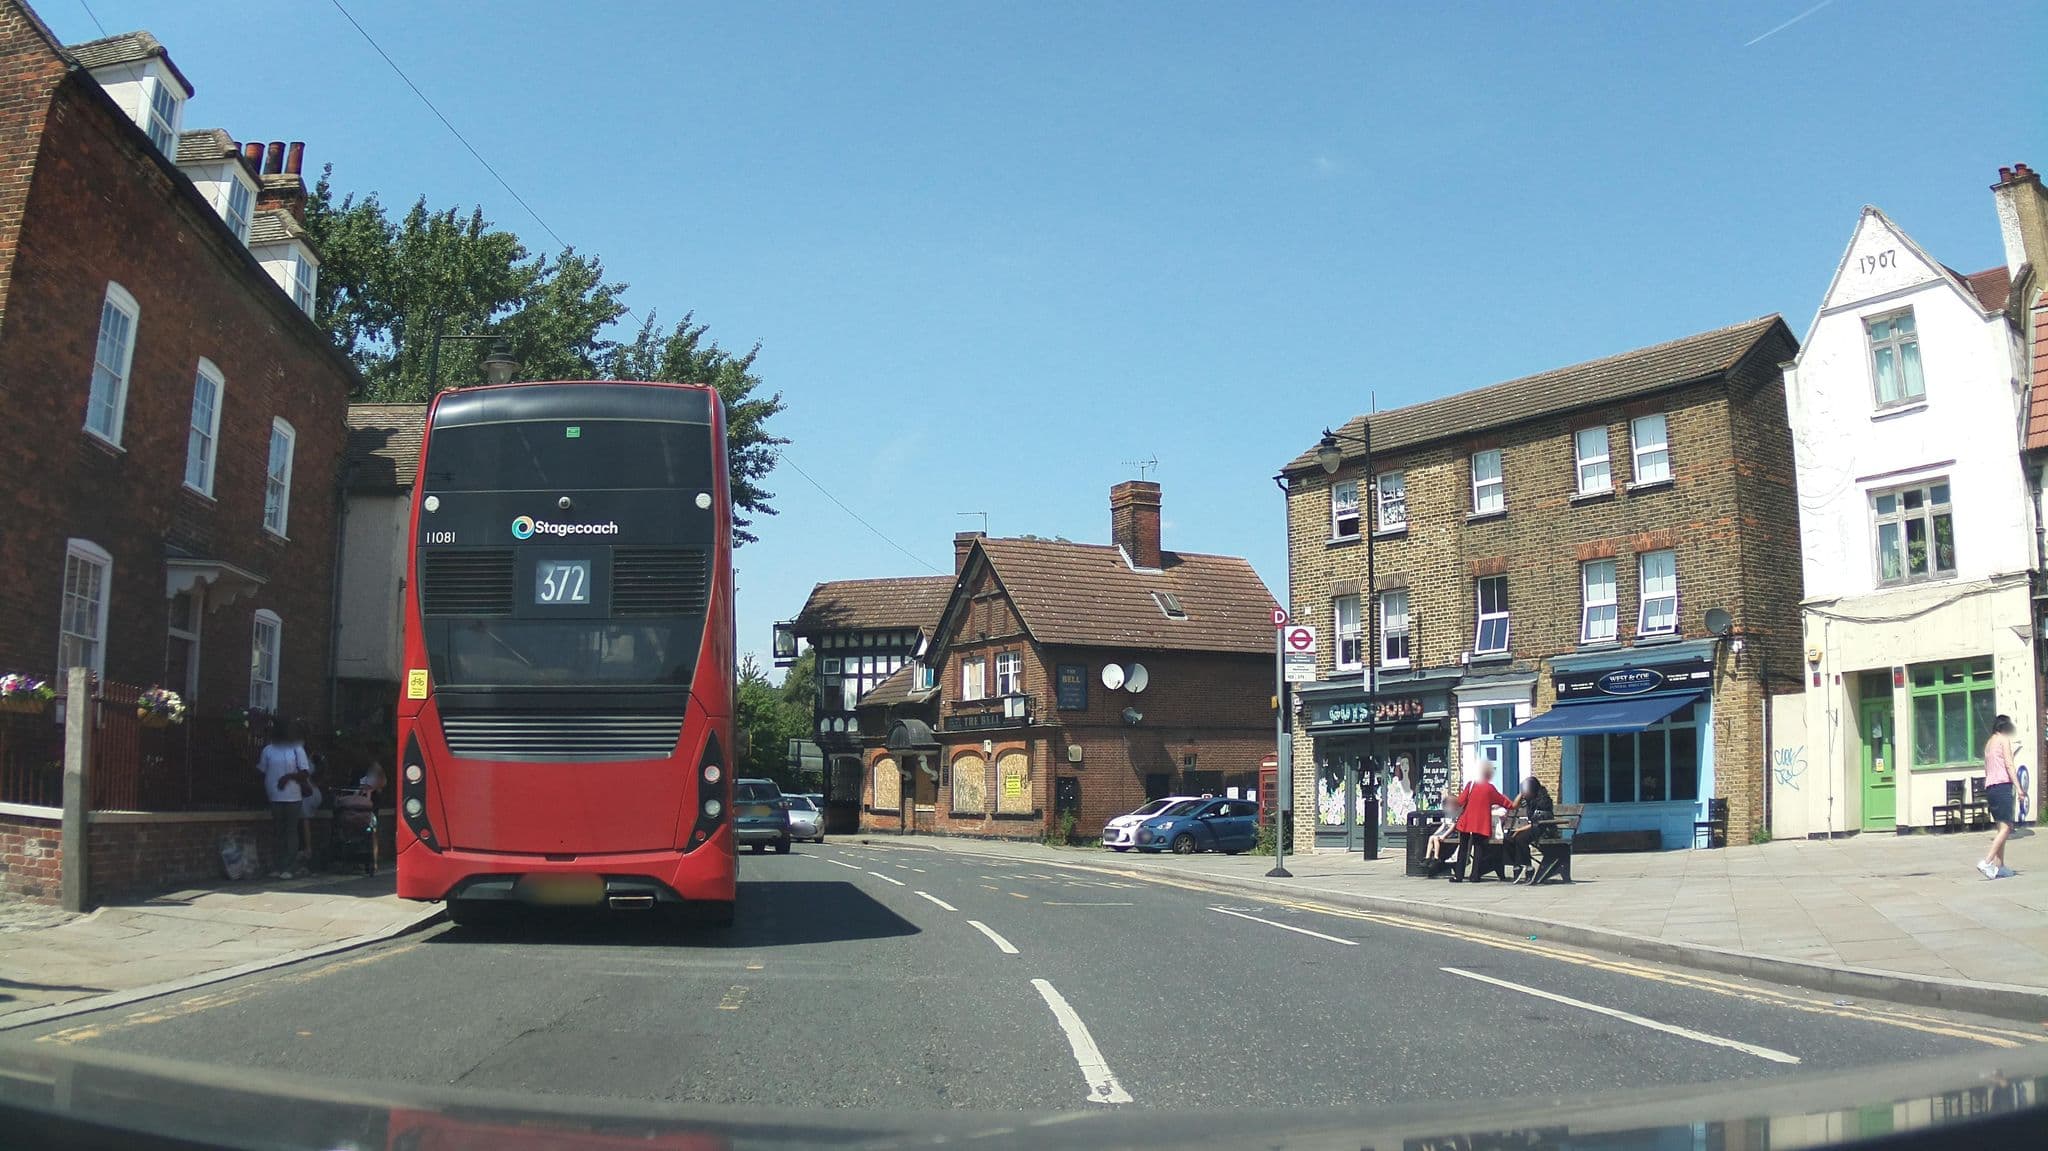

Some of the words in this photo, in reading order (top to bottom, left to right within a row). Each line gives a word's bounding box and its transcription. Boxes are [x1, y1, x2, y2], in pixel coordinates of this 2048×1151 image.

[1860, 249, 1896, 275] 1907
[535, 520, 618, 537] Stagecoach
[426, 531, 456, 544] 11081
[541, 565, 585, 601] 372
[1274, 610, 1286, 624] D
[1609, 675, 1629, 683] WEST
[1329, 702, 1369, 722] GUYS
